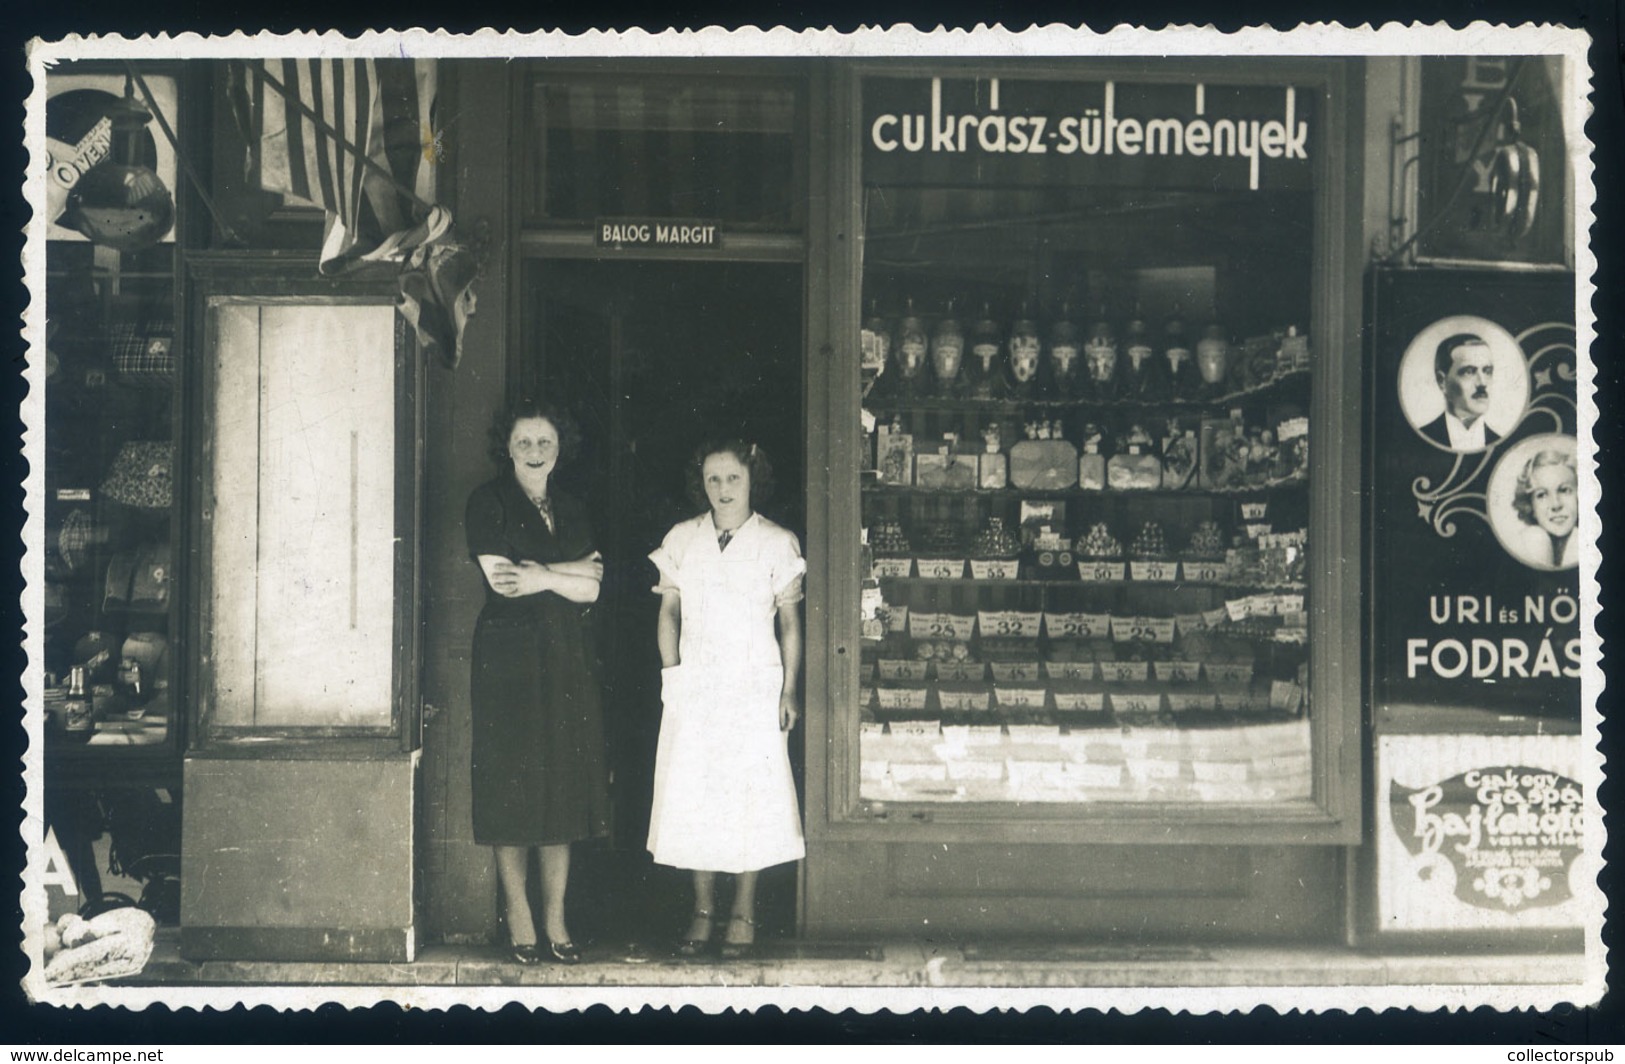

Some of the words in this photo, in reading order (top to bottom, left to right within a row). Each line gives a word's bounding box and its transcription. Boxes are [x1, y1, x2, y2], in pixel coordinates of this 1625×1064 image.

[602, 224, 651, 242] BALOG
[656, 224, 716, 244] MARGIT
[1430, 596, 1492, 625] URI
[1499, 607, 1518, 624] ÉS
[930, 622, 956, 637] 28
[997, 621, 1023, 637] 32
[1063, 622, 1092, 637] 26
[1407, 628, 1581, 679] FODRÁS
